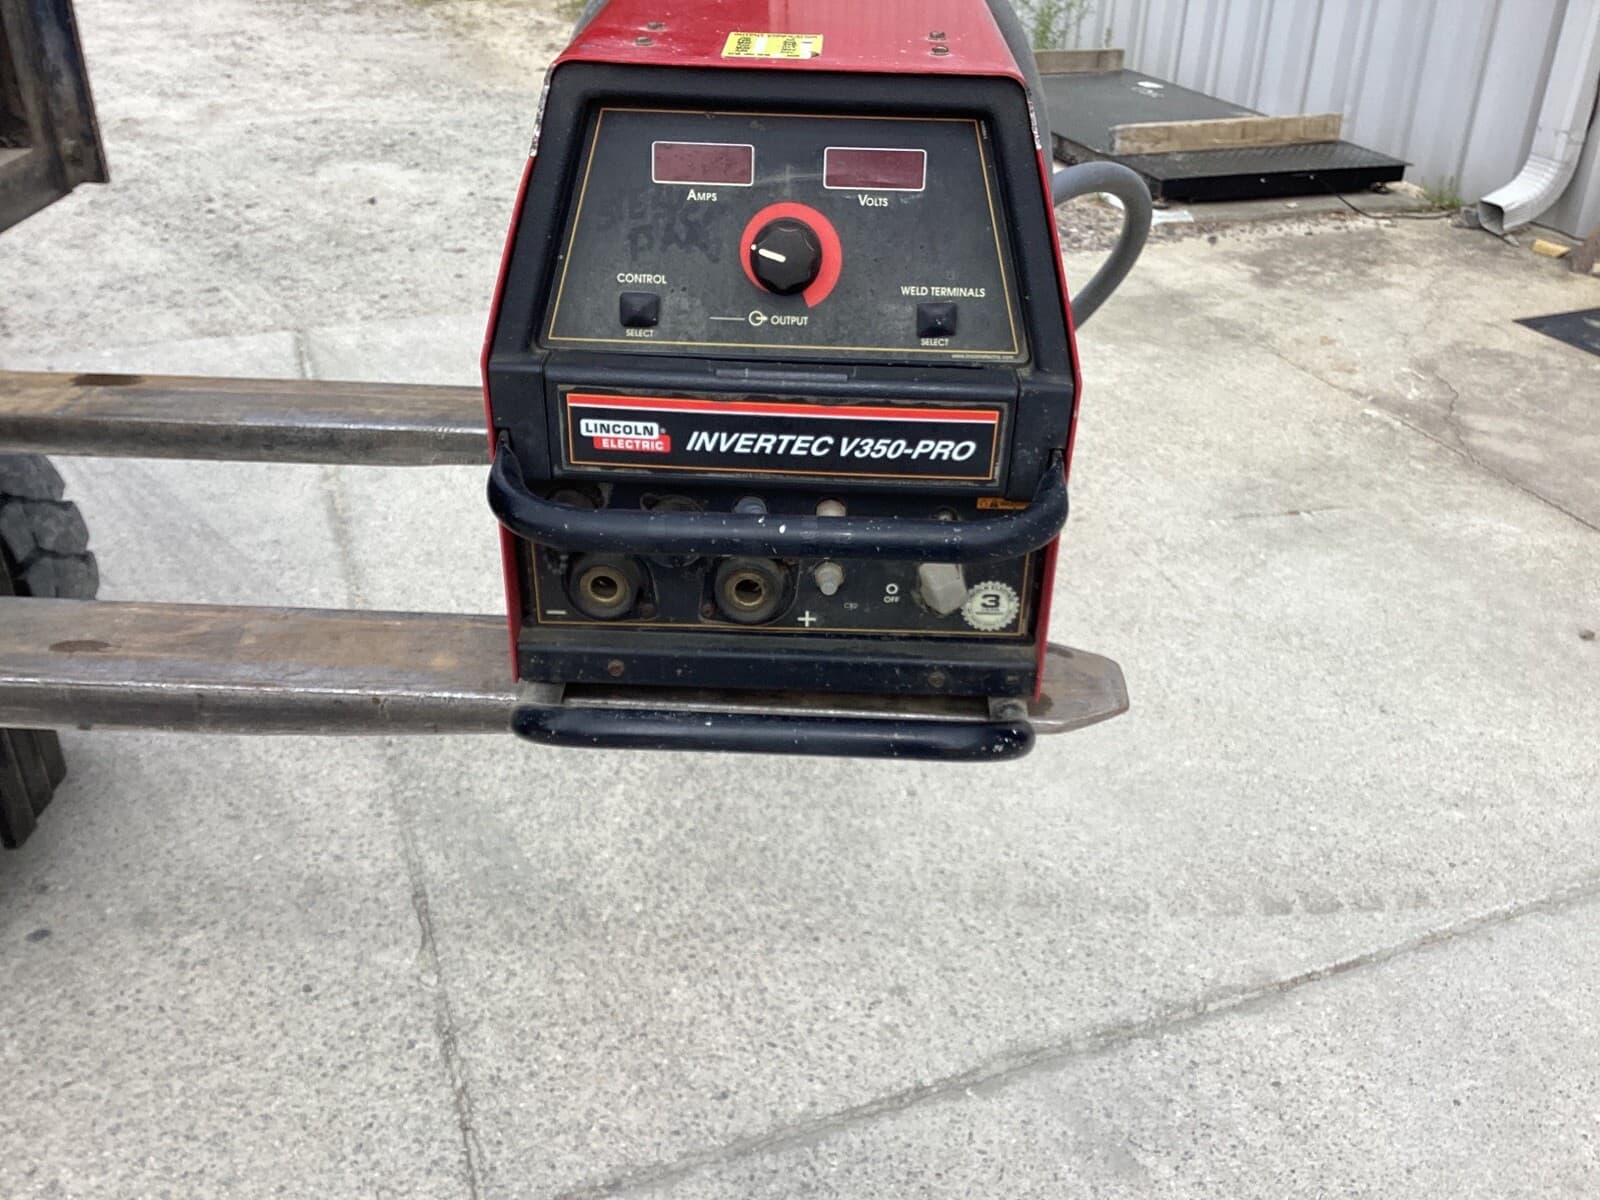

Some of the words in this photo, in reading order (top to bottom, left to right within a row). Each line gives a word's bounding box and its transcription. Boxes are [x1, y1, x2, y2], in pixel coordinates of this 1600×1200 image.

[616, 273, 668, 285] CONTROL
[900, 286, 929, 297] WELD
[930, 287, 986, 298] TERMINALS
[770, 315, 809, 326] OUTPUT
[625, 328, 655, 338] SELECT
[920, 338, 949, 347] SELECT
[583, 421, 655, 436] LINCOLN
[601, 437, 665, 452] ELECTRIC
[686, 431, 834, 456] INVERTEC
[839, 438, 977, 462] V350-PRO
[884, 596, 900, 604] OFF
[980, 593, 1001, 609] 3
